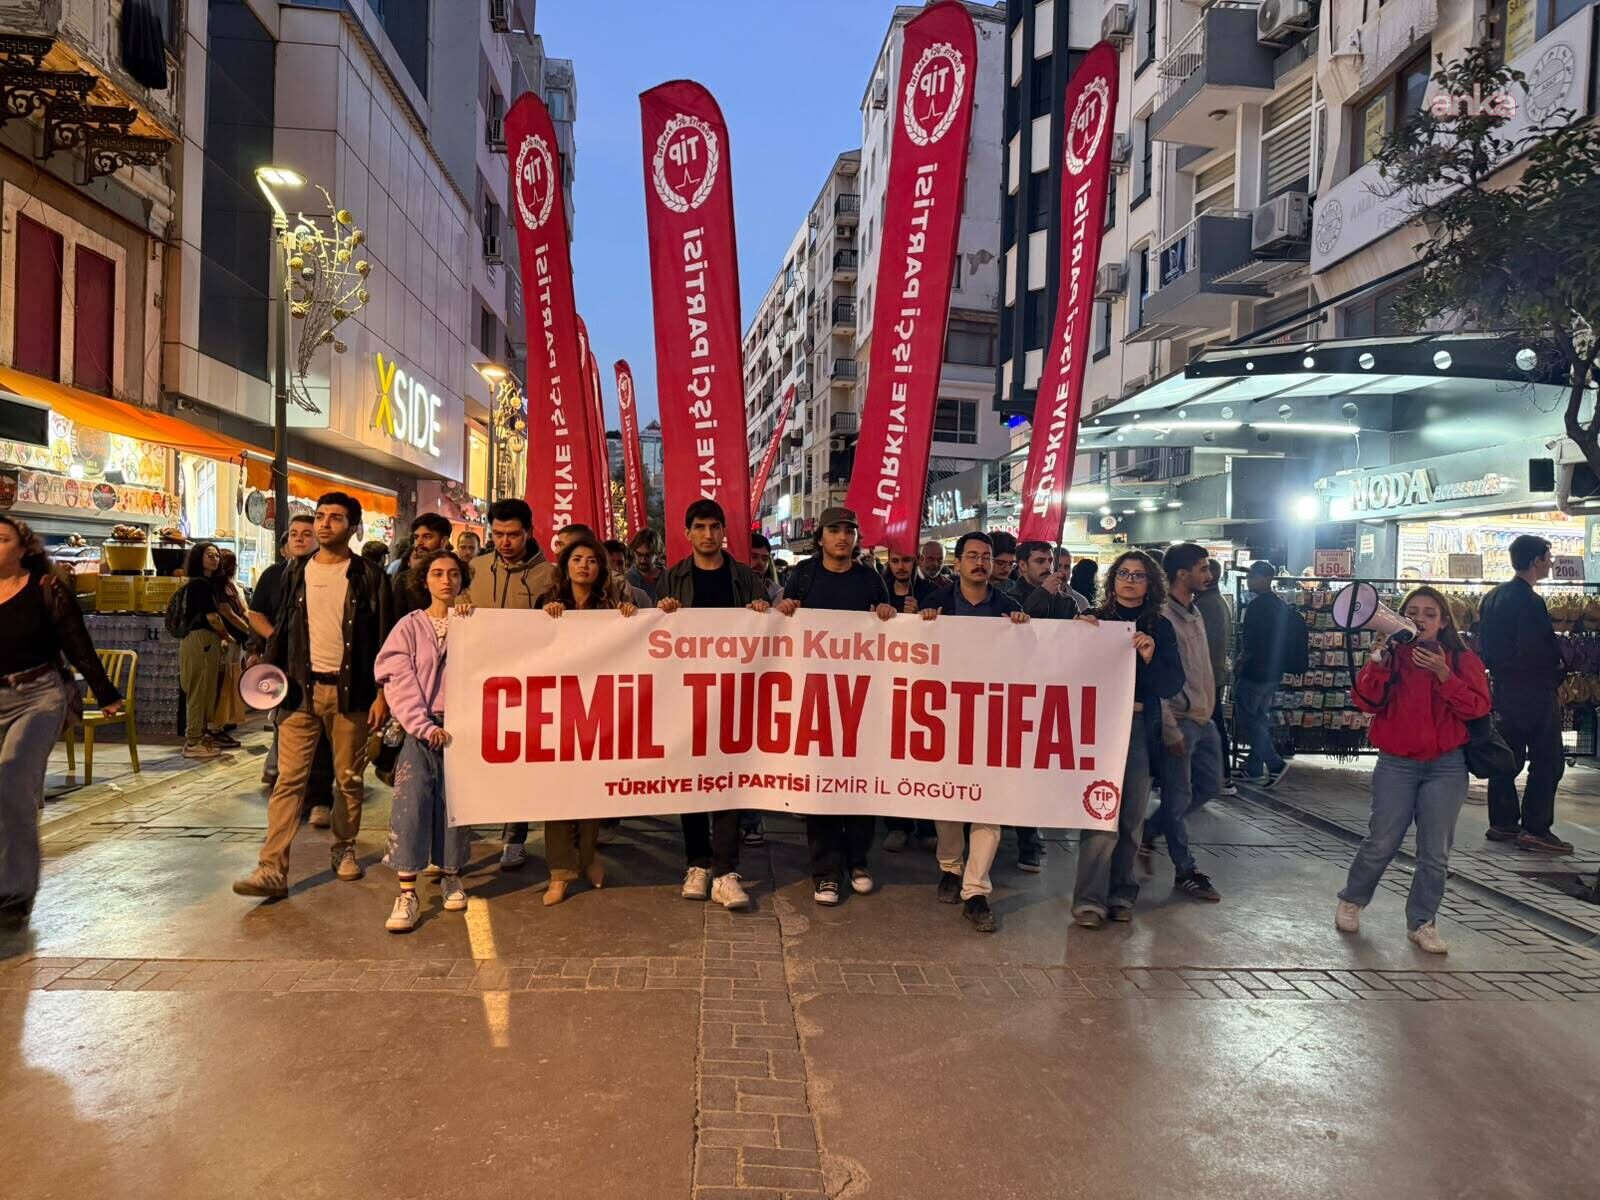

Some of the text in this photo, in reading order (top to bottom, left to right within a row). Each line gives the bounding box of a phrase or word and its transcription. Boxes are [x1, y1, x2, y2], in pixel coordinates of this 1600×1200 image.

[375, 352, 442, 458] XSIDE
[648, 629, 941, 666] Sarayın Kuklası
[481, 671, 1097, 771] CEMİL TUGAY İSTİFA!
[605, 771, 983, 802] TÜRKİYE İŞÇİ PARTİSİ İZMİR İL ÖRGÜTÜ
[1093, 789, 1113, 801] TİP
